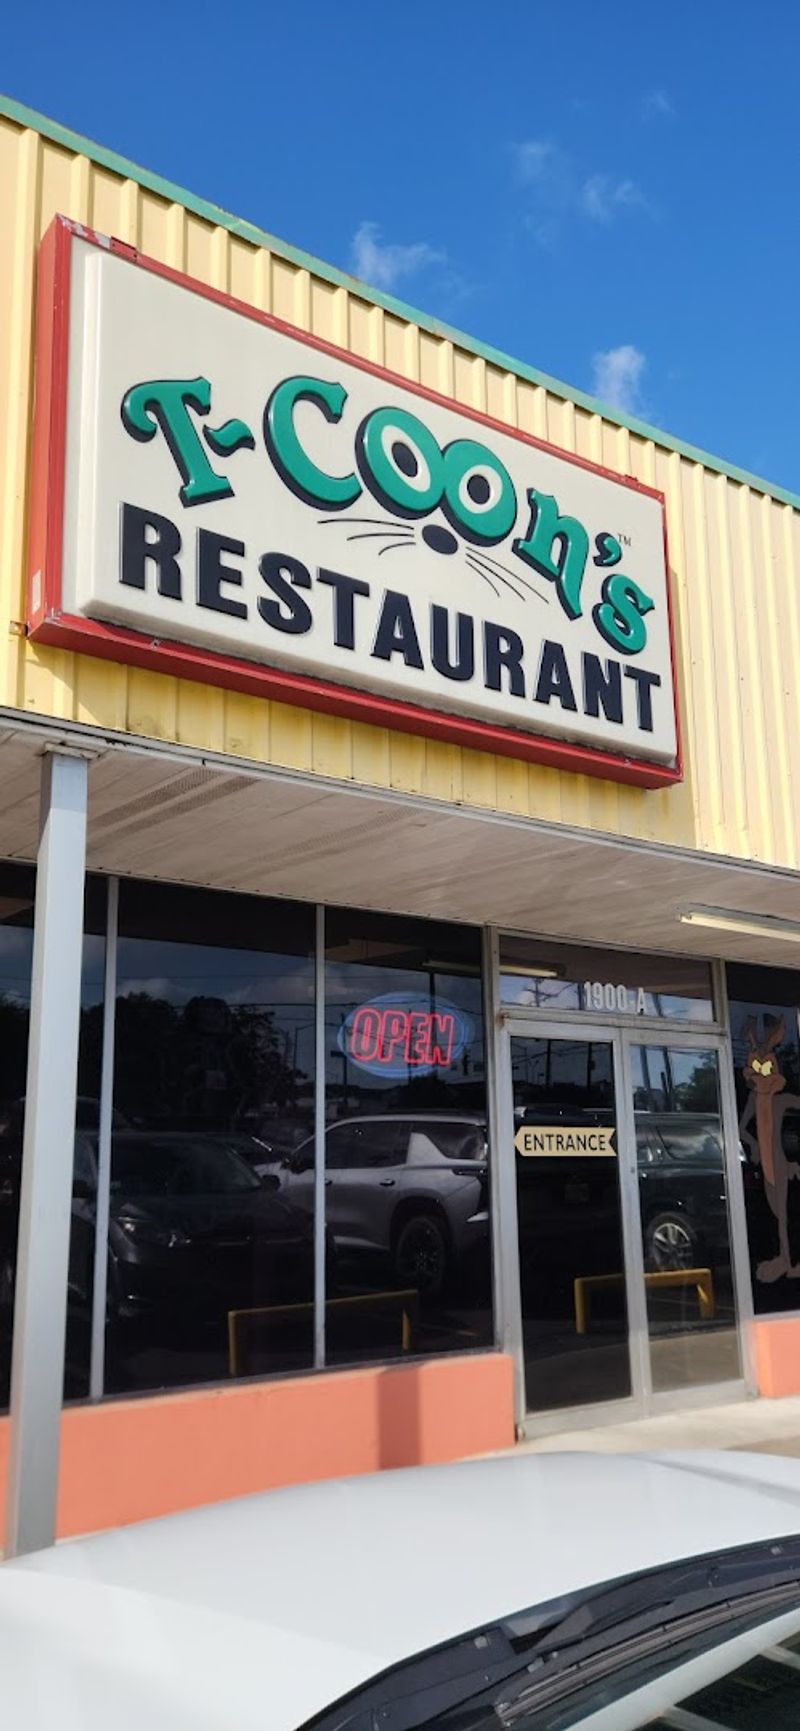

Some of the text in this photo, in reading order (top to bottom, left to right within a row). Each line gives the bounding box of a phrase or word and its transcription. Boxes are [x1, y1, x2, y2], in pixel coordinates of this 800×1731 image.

[118, 501, 662, 733] RESTAURANT
[584, 981, 647, 1014] 1900-A
[349, 1008, 455, 1066] OPEN
[523, 1133, 607, 1152] ENTRANCE
